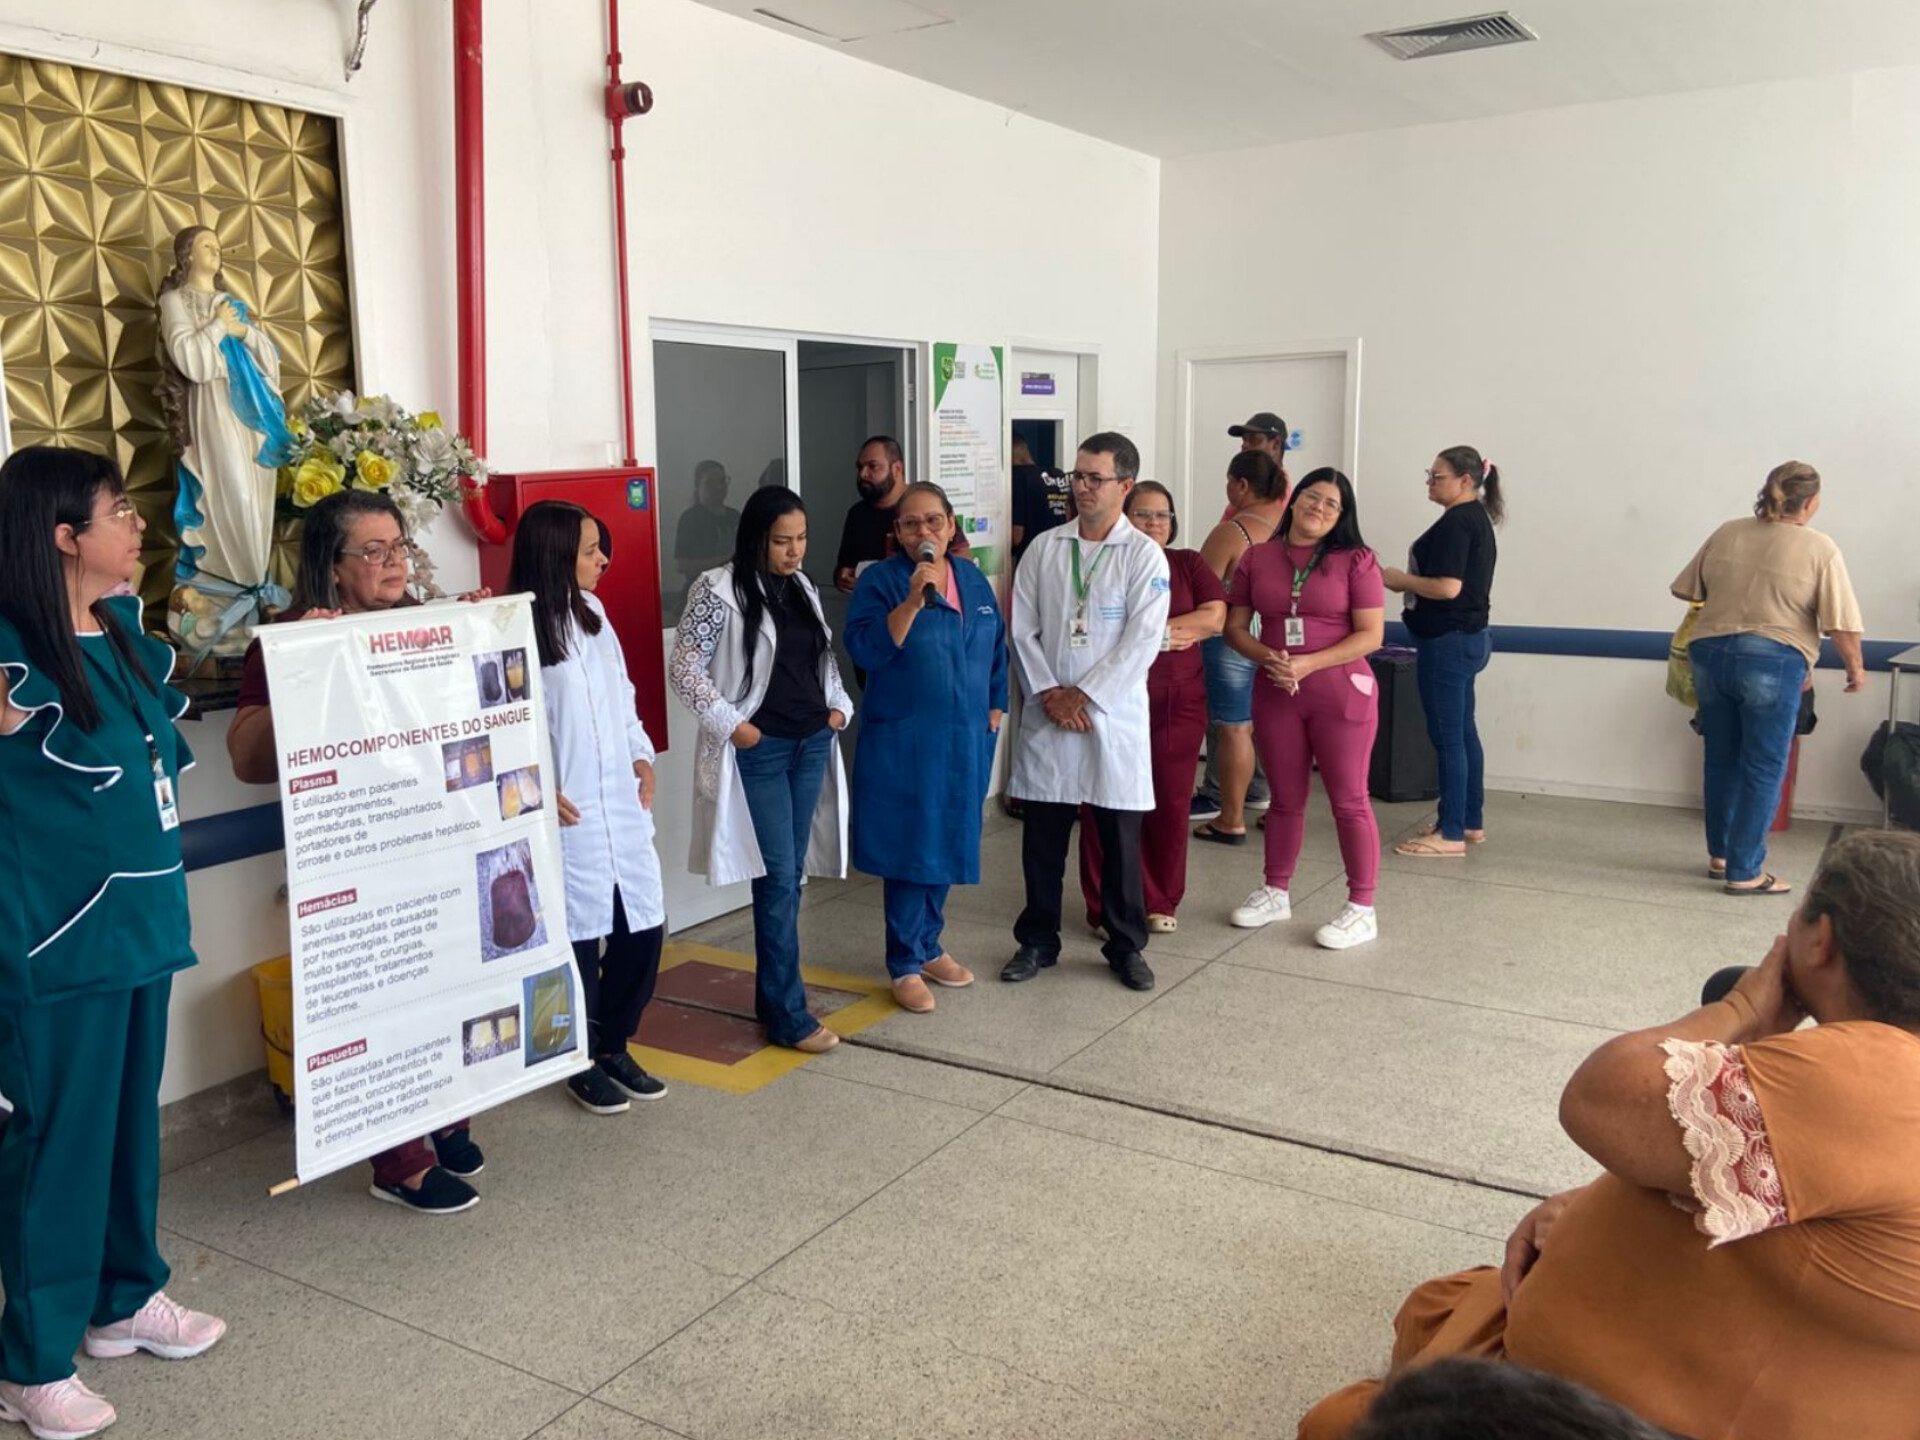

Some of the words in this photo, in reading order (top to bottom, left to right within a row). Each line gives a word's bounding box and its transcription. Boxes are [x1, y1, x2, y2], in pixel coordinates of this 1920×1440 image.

[287, 722, 459, 769] HEMOCOMPONENTES
[462, 718, 481, 735] DO
[484, 707, 531, 730] SANGUE
[291, 775, 333, 793] Plasma
[302, 790, 346, 808] utilizado
[349, 787, 366, 799] em
[369, 777, 418, 796] pacientes
[294, 812, 314, 826] com
[295, 817, 365, 841] queimaduras,
[295, 834, 351, 857] portadores
[354, 830, 367, 841] de
[297, 853, 331, 870] cirrose
[334, 851, 341, 860] e
[344, 843, 377, 858] outros
[380, 831, 433, 852] problemas
[435, 820, 481, 837] hepáticos
[299, 893, 354, 915] Hemácias
[301, 924, 321, 938] São
[324, 909, 374, 931] utilizadas
[377, 904, 393, 917] em
[395, 892, 438, 913] paciente
[440, 887, 461, 900] com
[302, 934, 346, 952] anemias
[349, 921, 388, 938] agudas
[390, 907, 439, 928] causadas
[303, 953, 319, 968] por
[393, 926, 423, 941] perda
[424, 920, 438, 931] de
[303, 965, 332, 981] muito
[374, 949, 434, 974] tratamentos
[305, 998, 319, 1010] de
[321, 982, 375, 1005] leucemias
[377, 979, 384, 988] e
[386, 964, 430, 985] doenças
[309, 1042, 365, 1069] Plaquetas
[310, 1076, 333, 1091] São
[335, 1058, 384, 1082] utilizadas
[386, 1052, 403, 1064] em
[405, 1034, 452, 1059] pacientes
[312, 1091, 332, 1106] que
[334, 1078, 367, 1096] fazem
[369, 1059, 429, 1084] tratamentos
[430, 1051, 443, 1062] de
[365, 1075, 415, 1100] oncologia
[417, 1067, 433, 1081] em
[313, 1101, 384, 1134] quimioterapia
[387, 1097, 394, 1107] e
[396, 1074, 453, 1104] radioterapia
[315, 1136, 322, 1147] e
